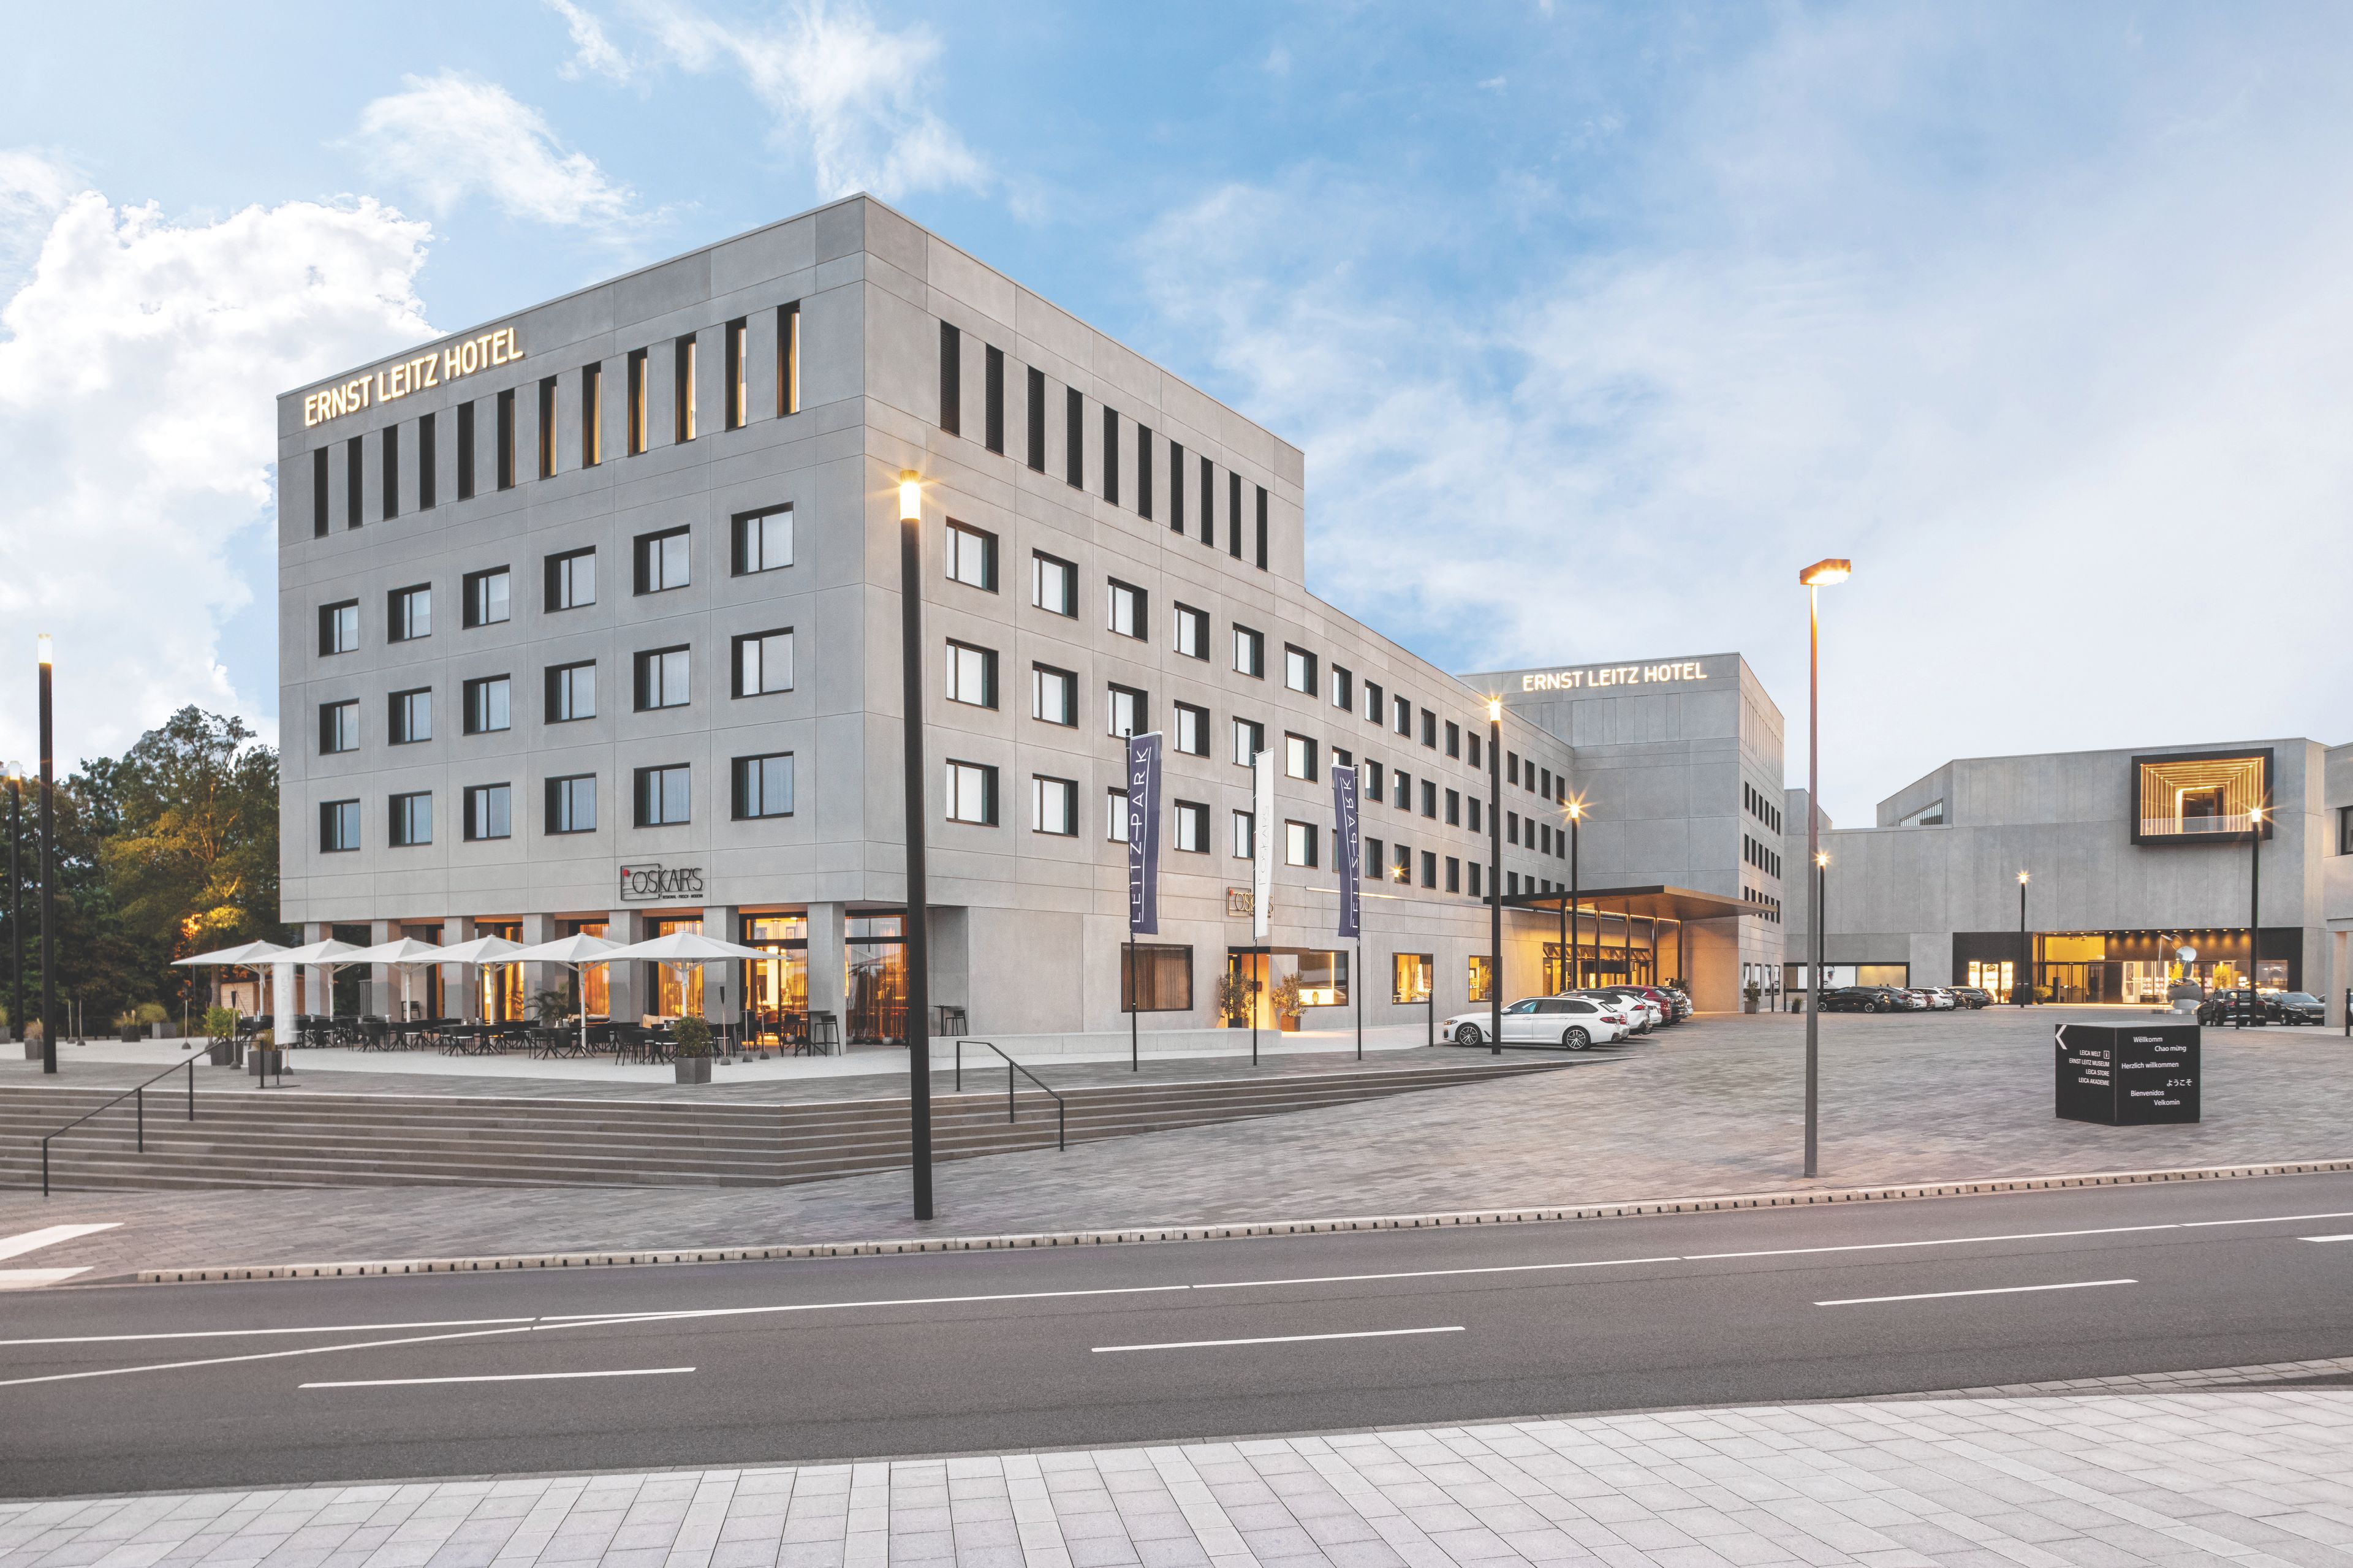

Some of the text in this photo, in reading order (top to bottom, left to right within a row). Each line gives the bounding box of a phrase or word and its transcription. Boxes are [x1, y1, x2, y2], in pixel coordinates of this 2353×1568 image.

[305, 327, 523, 426] ERNST LEITZ HOTEL
[1523, 662, 1707, 691] ERNST LEITZ HOTEL
